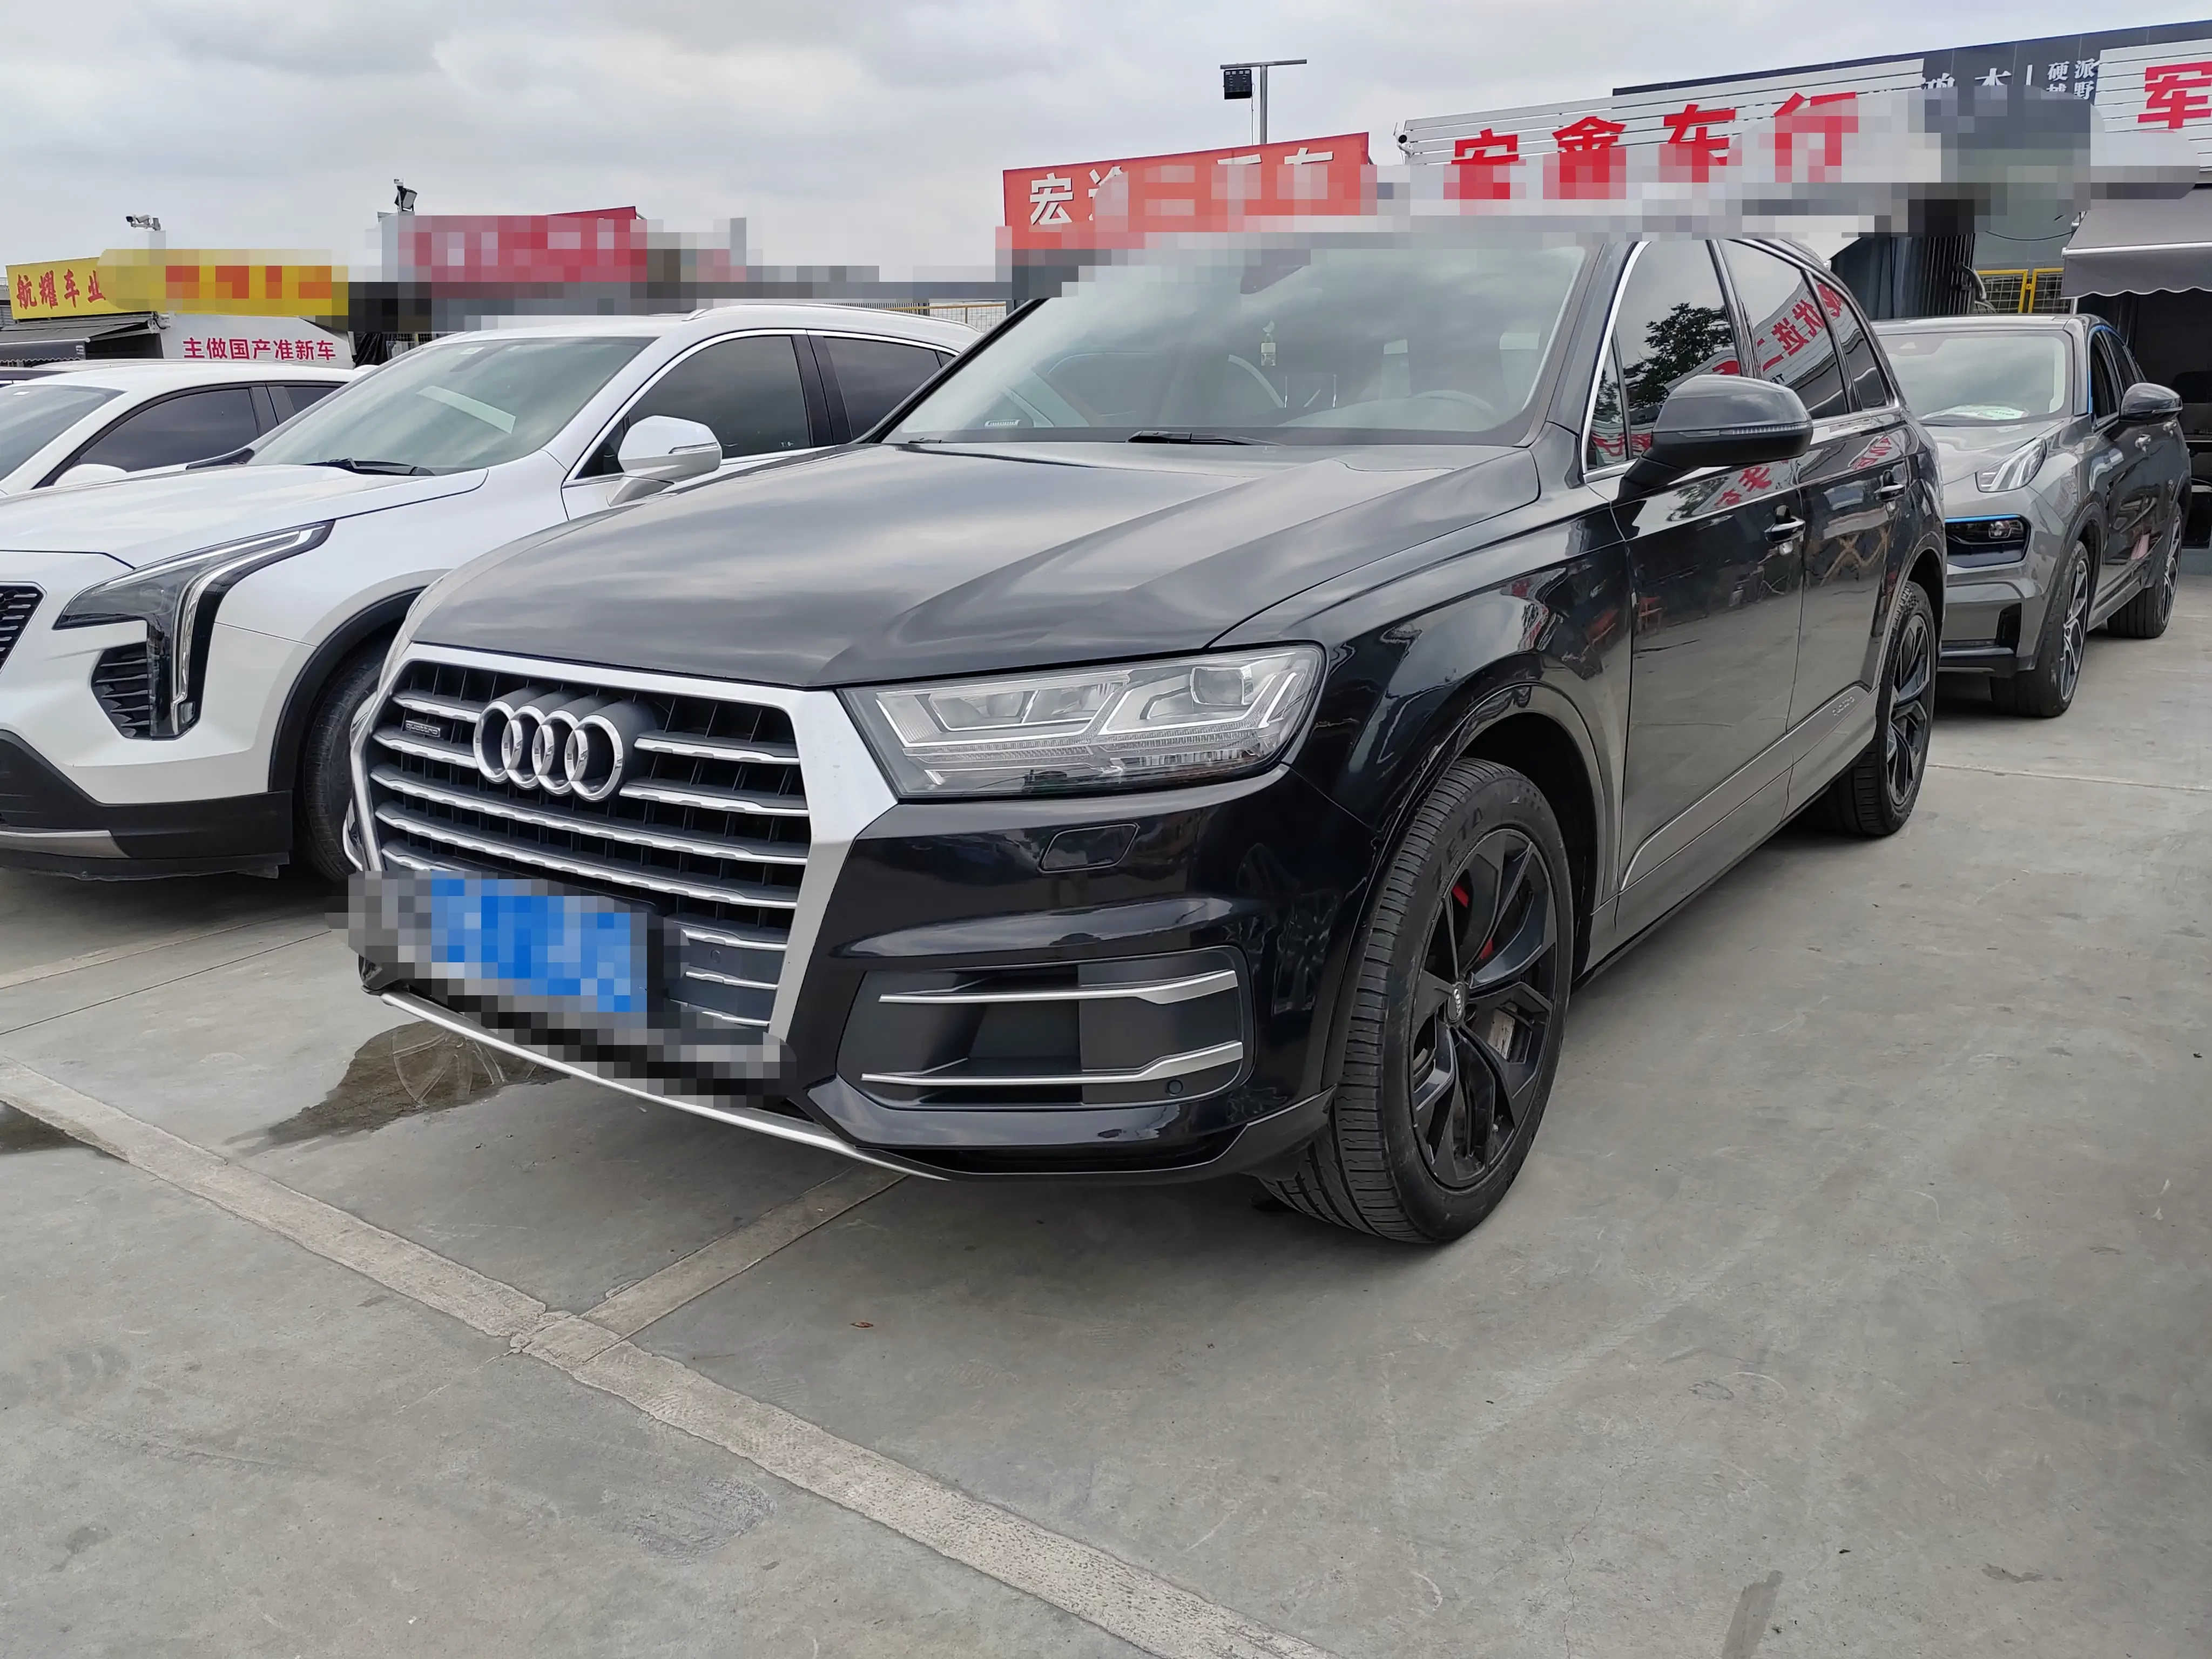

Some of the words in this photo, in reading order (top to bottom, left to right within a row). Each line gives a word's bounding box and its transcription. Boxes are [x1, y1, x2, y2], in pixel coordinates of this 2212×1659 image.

[182, 337, 336, 361] 主做国产准新车
[406, 723, 439, 736] quattro
